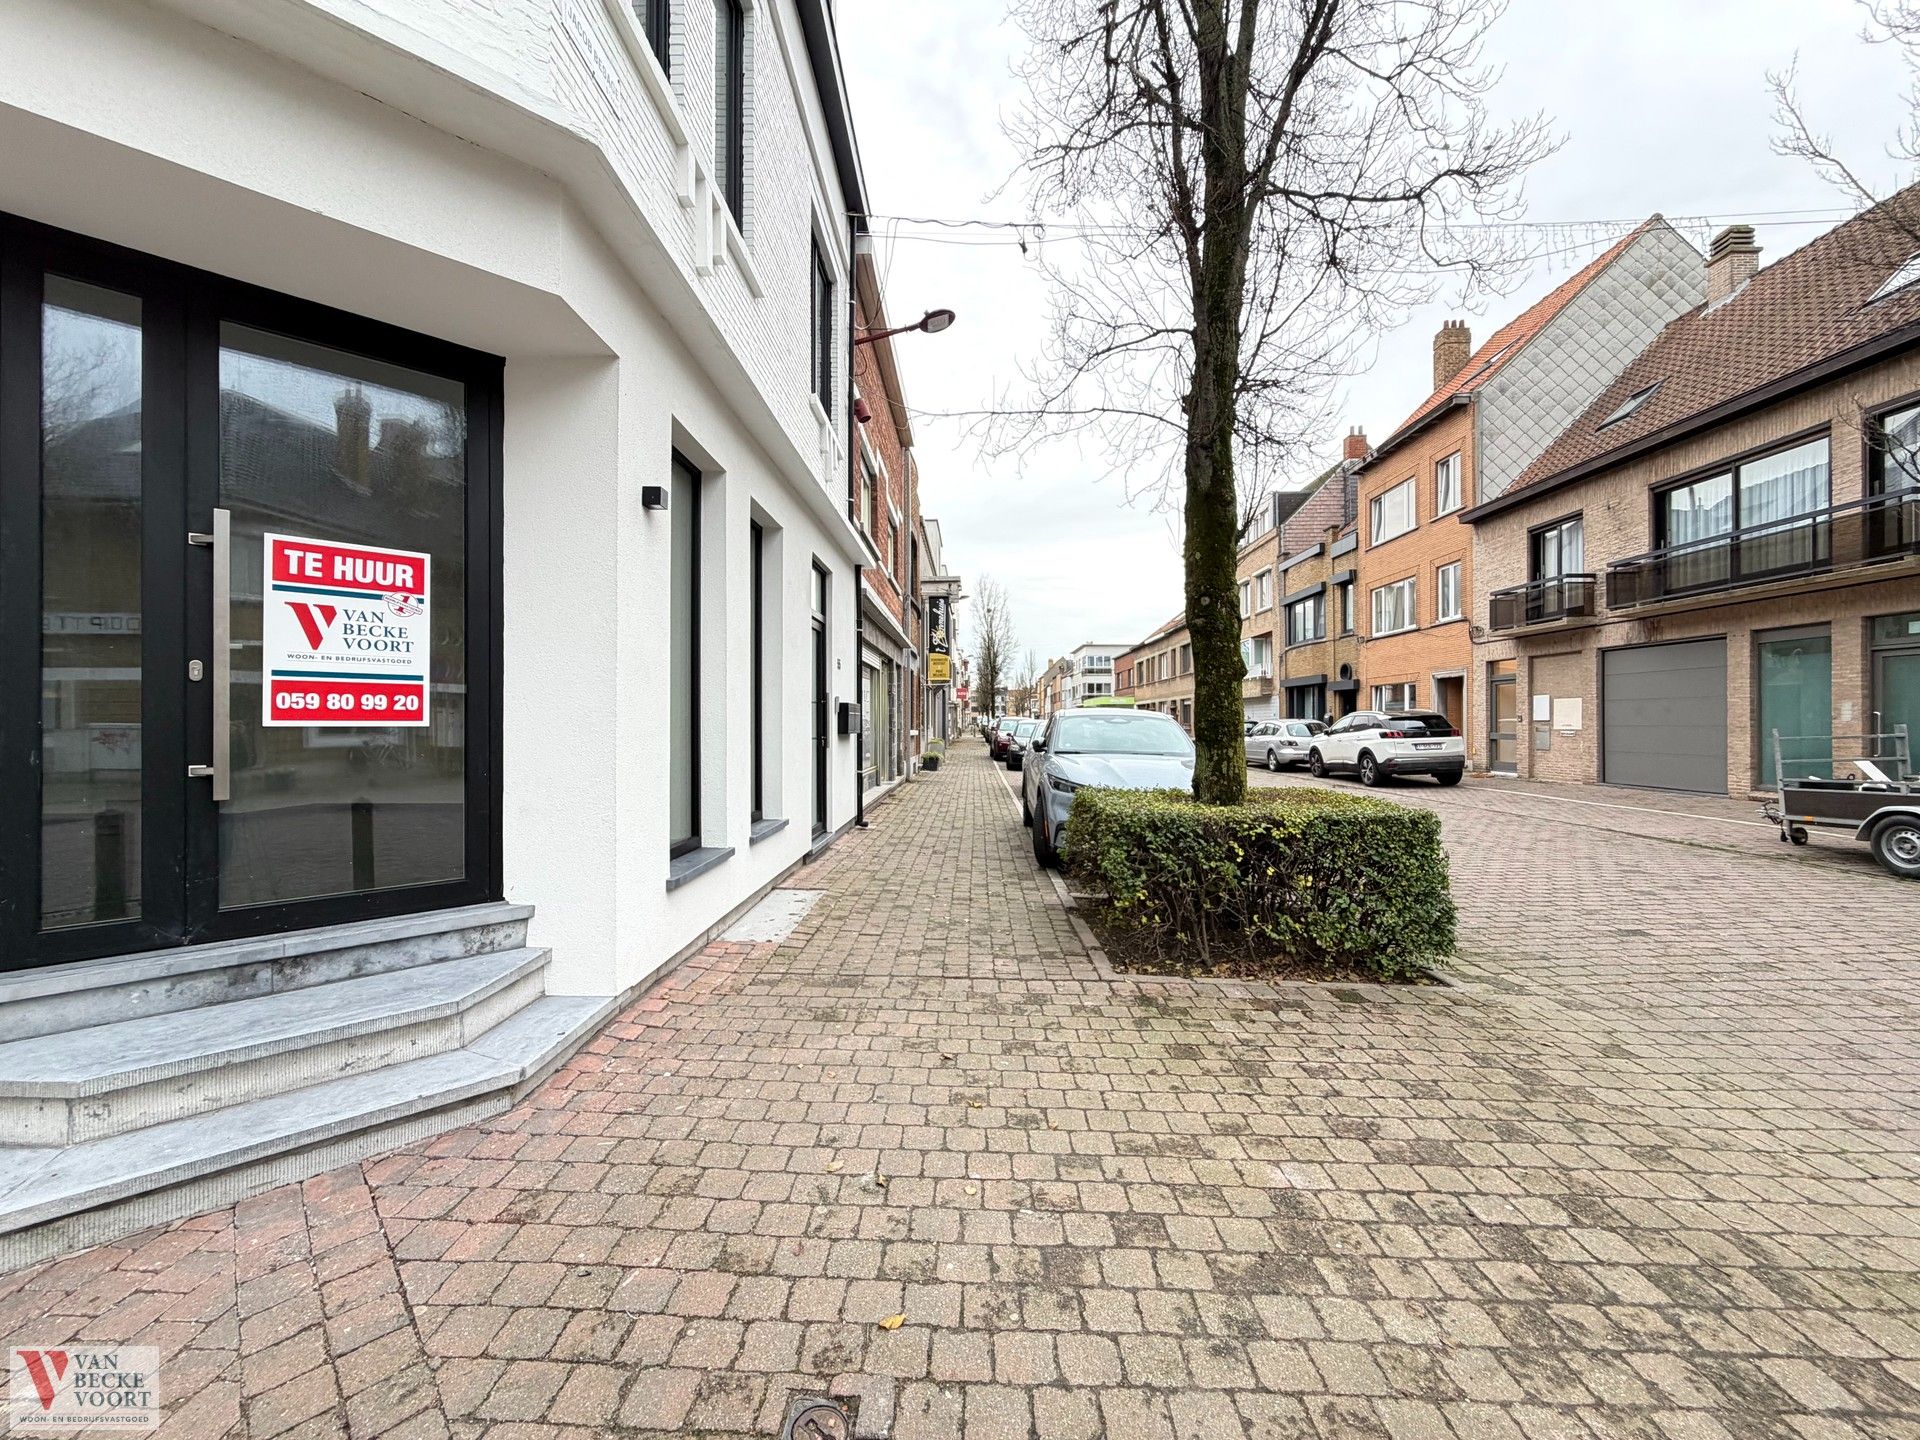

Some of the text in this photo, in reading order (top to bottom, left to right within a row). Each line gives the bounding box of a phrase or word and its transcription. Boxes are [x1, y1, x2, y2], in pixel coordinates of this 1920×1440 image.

[568, 6, 592, 54] JACOB
[284, 549, 414, 588] TE HUUR
[343, 609, 384, 624] VAN
[343, 623, 409, 639] BECKE
[343, 637, 415, 653] VOORT
[287, 653, 318, 661] WOON-
[335, 656, 413, 665] BEDRIJFSVASTGOED
[275, 692, 419, 711] 059 80 99 20
